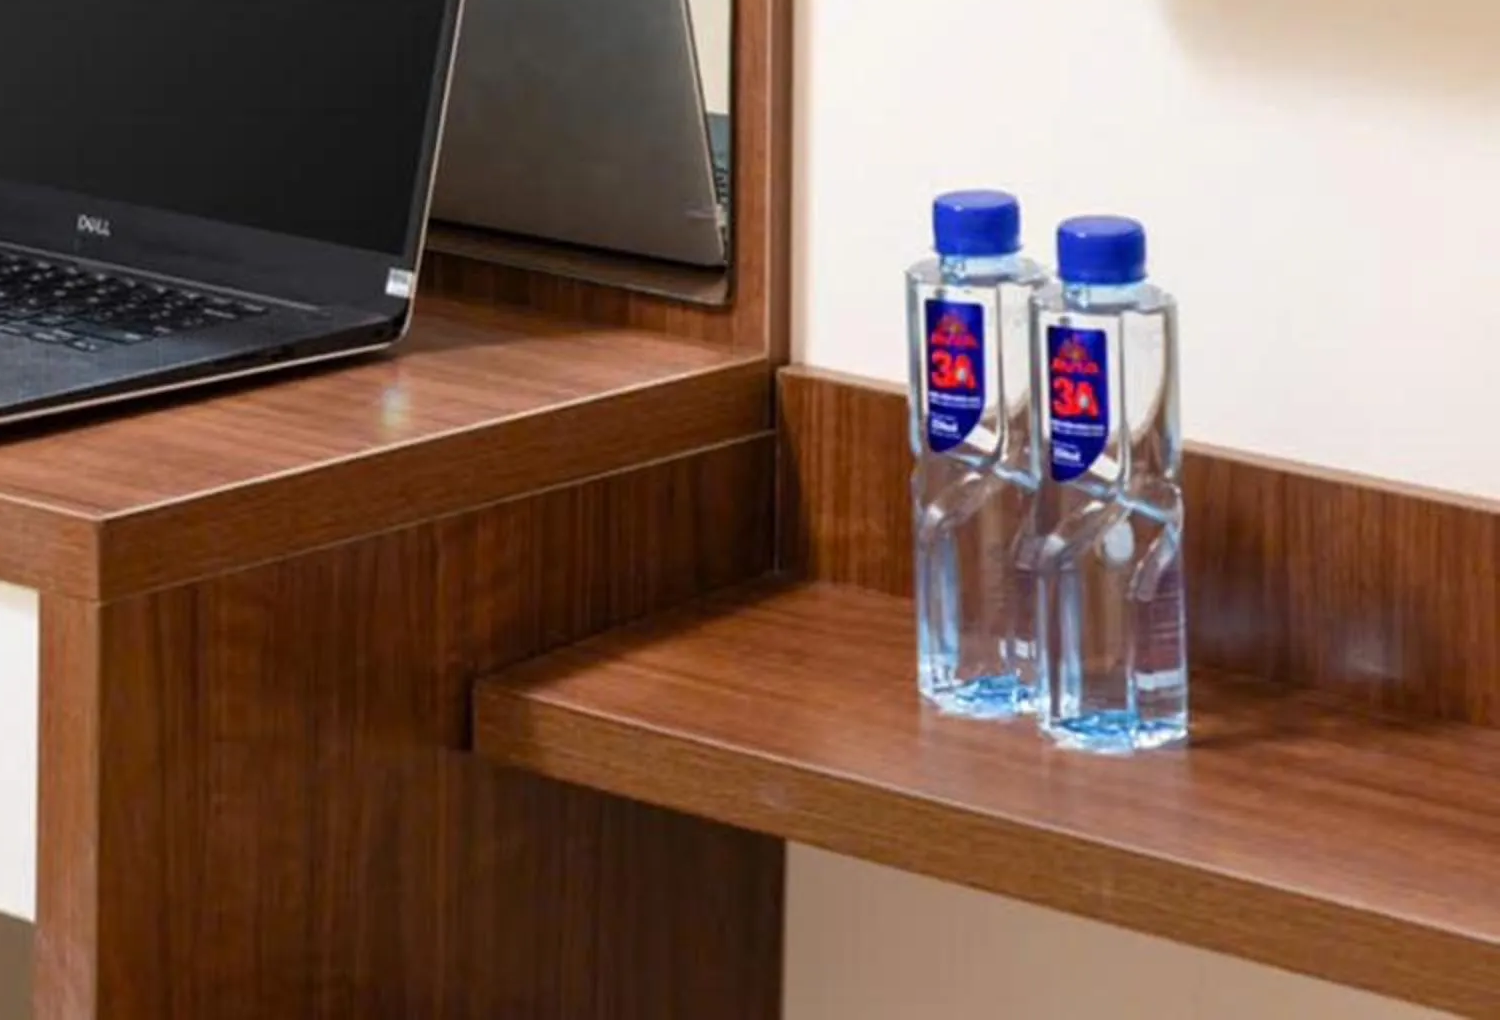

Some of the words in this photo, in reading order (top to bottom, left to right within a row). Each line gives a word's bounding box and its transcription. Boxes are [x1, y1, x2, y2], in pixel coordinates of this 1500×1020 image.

[77, 214, 111, 237] DELL
[931, 349, 977, 390] 3A
[1053, 376, 1099, 418] 3A
